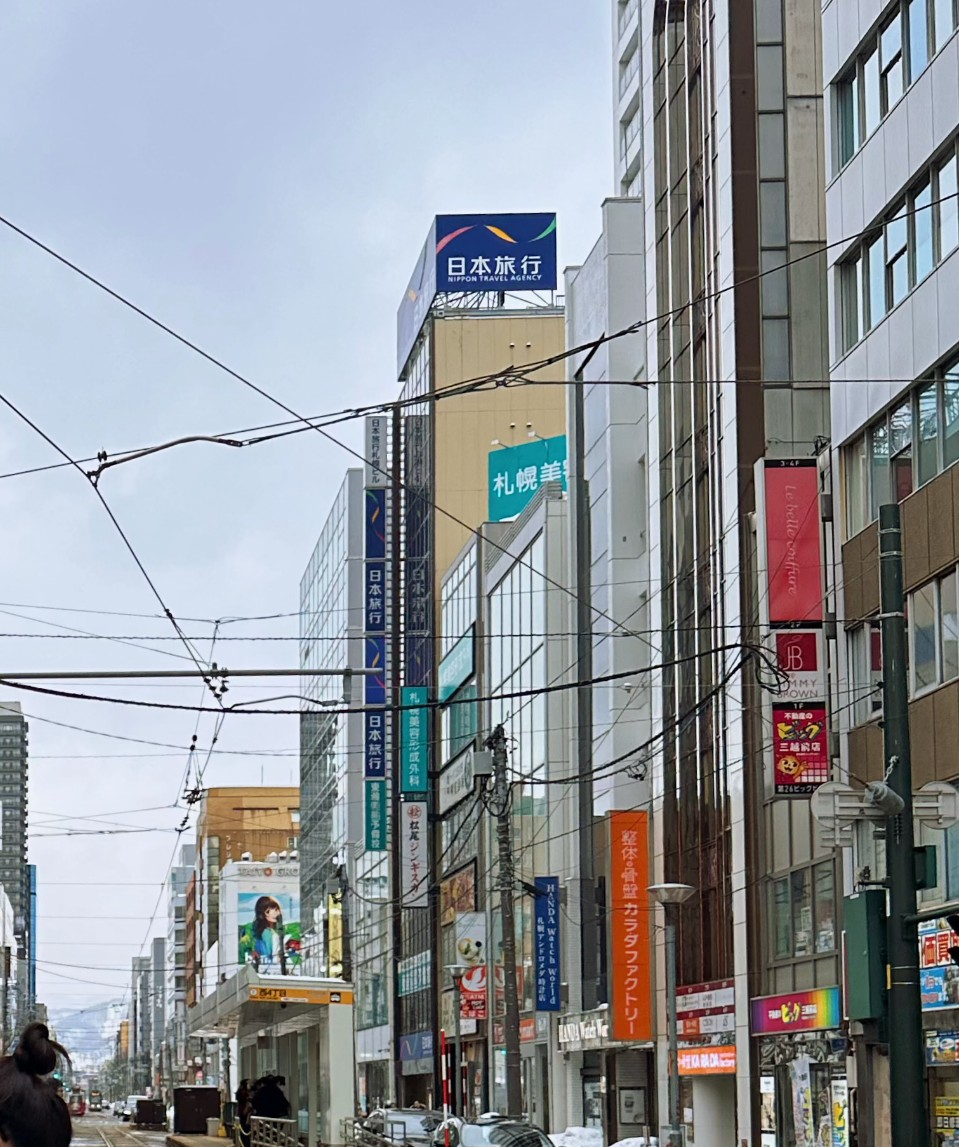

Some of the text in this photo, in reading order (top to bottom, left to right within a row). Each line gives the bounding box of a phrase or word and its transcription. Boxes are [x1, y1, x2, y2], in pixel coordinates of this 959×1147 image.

[447, 255, 542, 276] 日本旅行
[447, 275, 478, 283] NIPPON
[510, 274, 542, 282] AGENCY
[492, 460, 568, 498] 札幌美
[368, 569, 383, 625] 日本旅行
[777, 719, 824, 741] ビッグ
[784, 712, 813, 720] 不動産の
[368, 715, 382, 770] 日本旅行
[779, 742, 821, 752] 三越前店
[547, 884, 556, 924] HANDA
[547, 928, 557, 964] Watch
